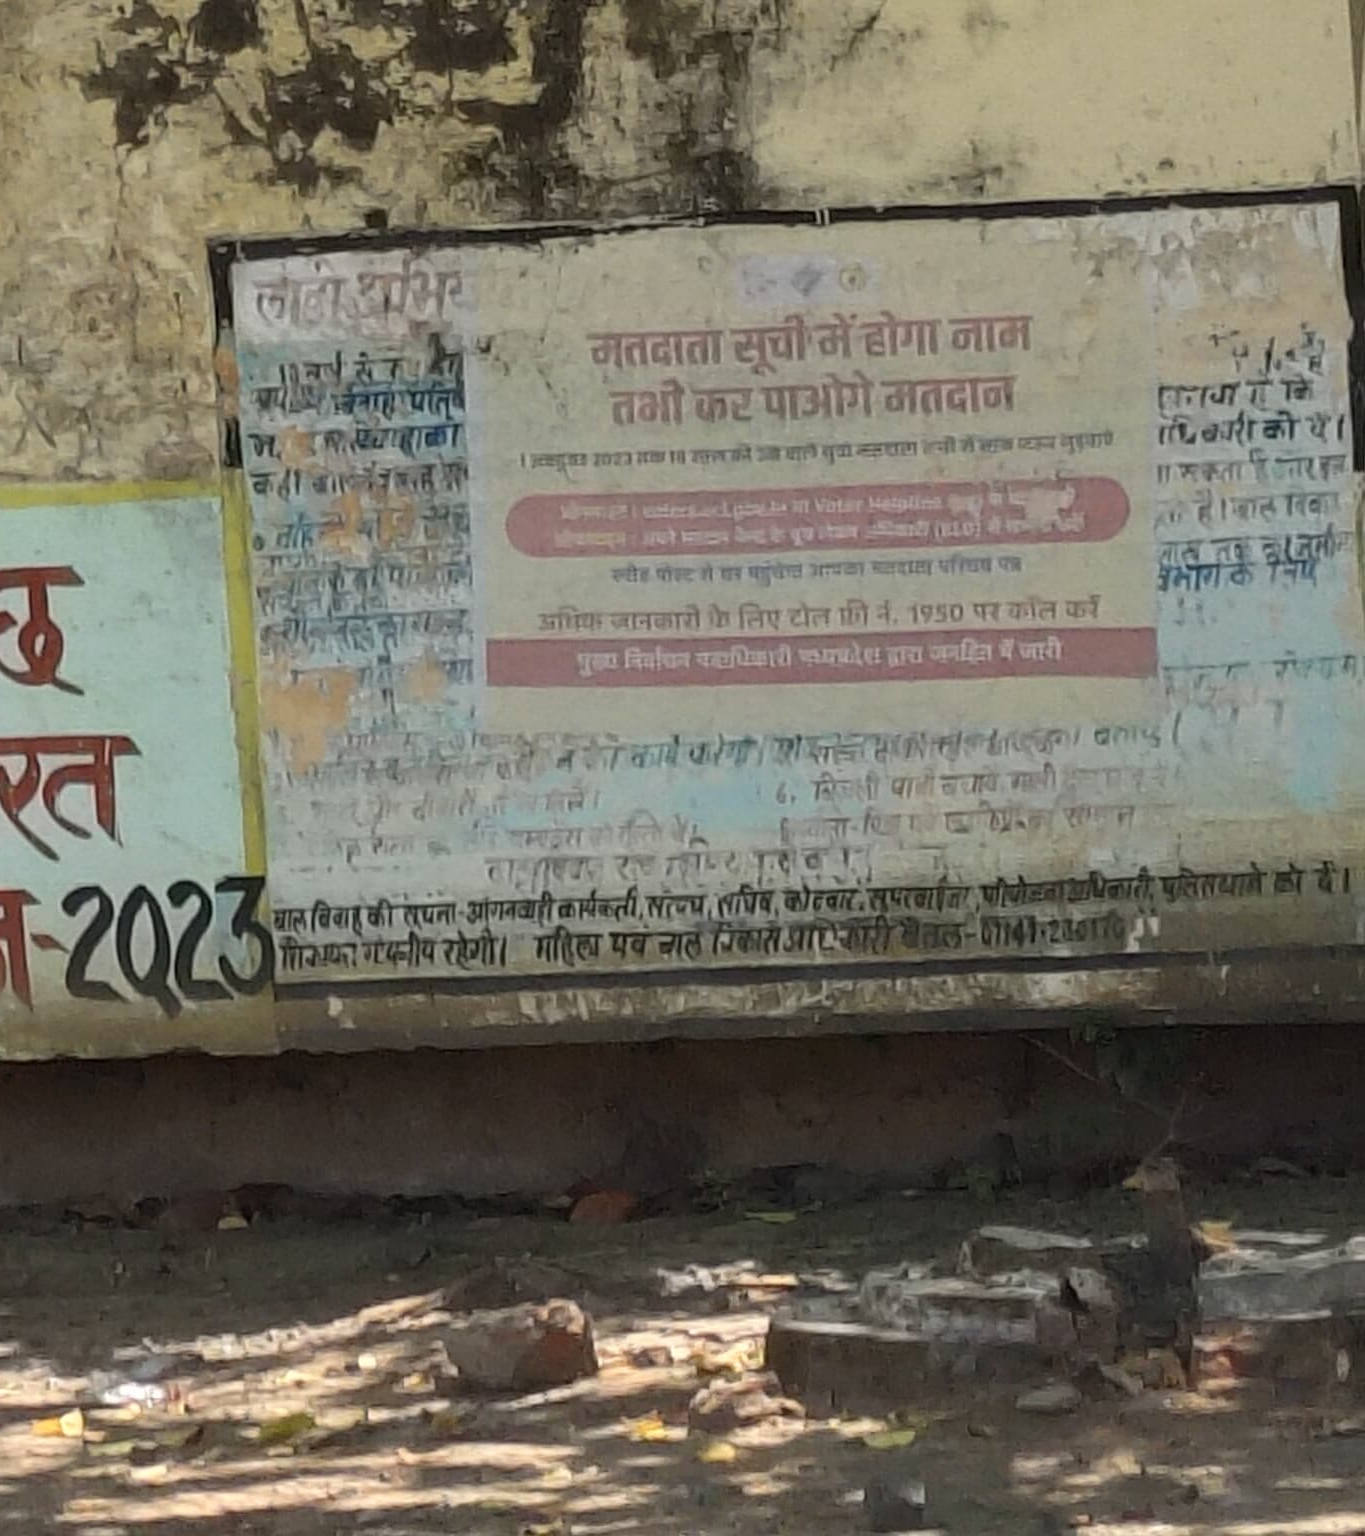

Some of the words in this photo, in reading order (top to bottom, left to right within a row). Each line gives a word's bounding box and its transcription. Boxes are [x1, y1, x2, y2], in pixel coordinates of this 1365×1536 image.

[585, 328, 723, 368] मतदाता
[728, 314, 809, 374] सूची
[815, 311, 858, 359] में
[860, 309, 942, 357] होगा
[947, 314, 1033, 352] नाम
[609, 375, 685, 426] तभी
[689, 386, 754, 424] कर
[759, 368, 875, 419] पाओगे
[879, 373, 1021, 416] मतदान
[814, 494, 865, 515] Voter
[538, 603, 602, 633] अधिक
[609, 601, 701, 632] जानकारी
[706, 600, 730, 630] के
[737, 601, 783, 631] लिए
[787, 598, 832, 629] टोल
[909, 600, 965, 626] 1950
[971, 598, 1002, 622] पर
[1006, 592, 1059, 622] कॉल
[1063, 593, 1103, 621] करें
[624, 644, 691, 672] निर्वाचन
[884, 643, 923, 669] द्वारा
[927, 636, 993, 665] जनहित
[997, 636, 1017, 663] में
[1018, 634, 1064, 663] जारी
[272, 906, 309, 935] बाल
[310, 897, 364, 938] विवाह
[366, 896, 394, 930] की
